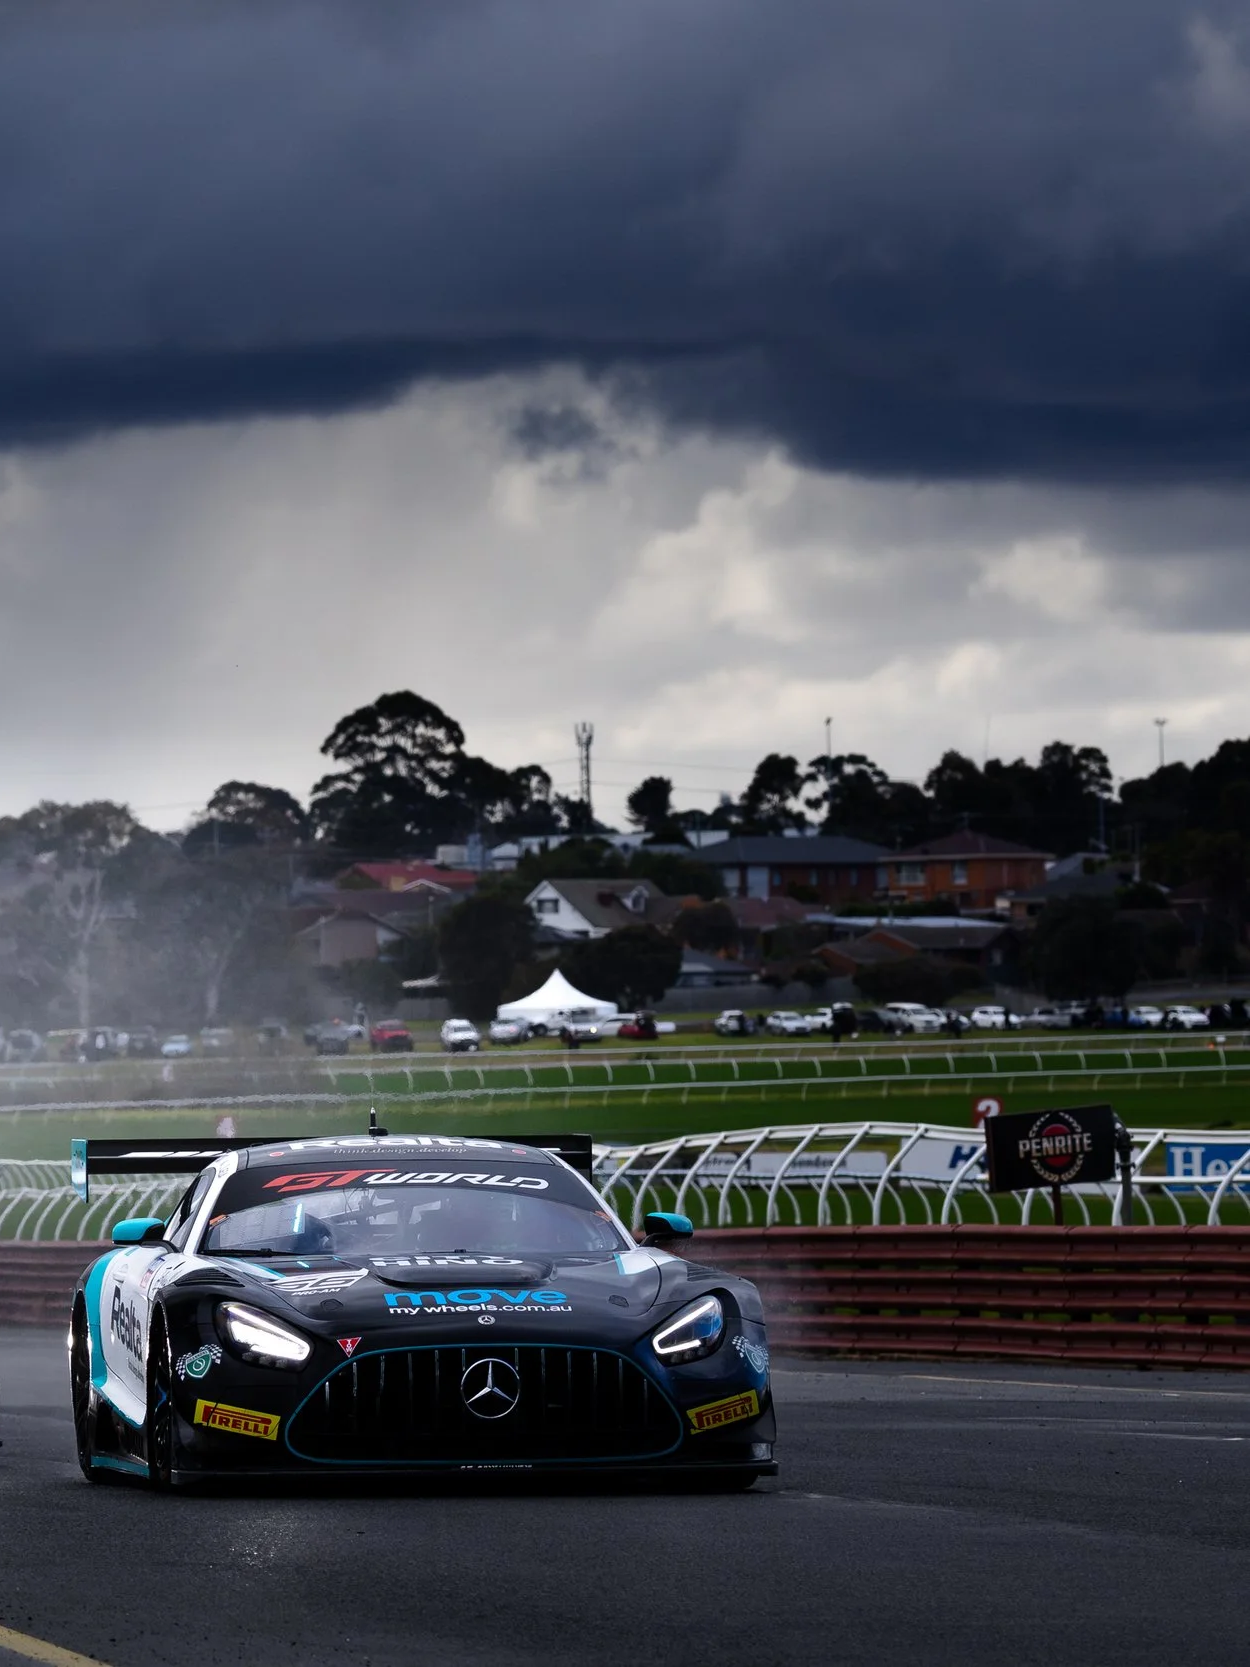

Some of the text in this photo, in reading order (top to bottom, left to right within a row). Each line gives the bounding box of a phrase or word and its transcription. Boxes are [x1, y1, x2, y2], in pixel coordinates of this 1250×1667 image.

[1018, 1133, 1093, 1159] PENRITE
[262, 1168, 549, 1192] GT WORLD
[373, 1259, 523, 1267] HINO
[383, 1289, 567, 1306] move
[389, 1303, 573, 1315] my wheels.com.au
[111, 1285, 144, 1364] Realta
[202, 1405, 272, 1435] PIRELLI
[695, 1396, 754, 1429] PIRELLI
